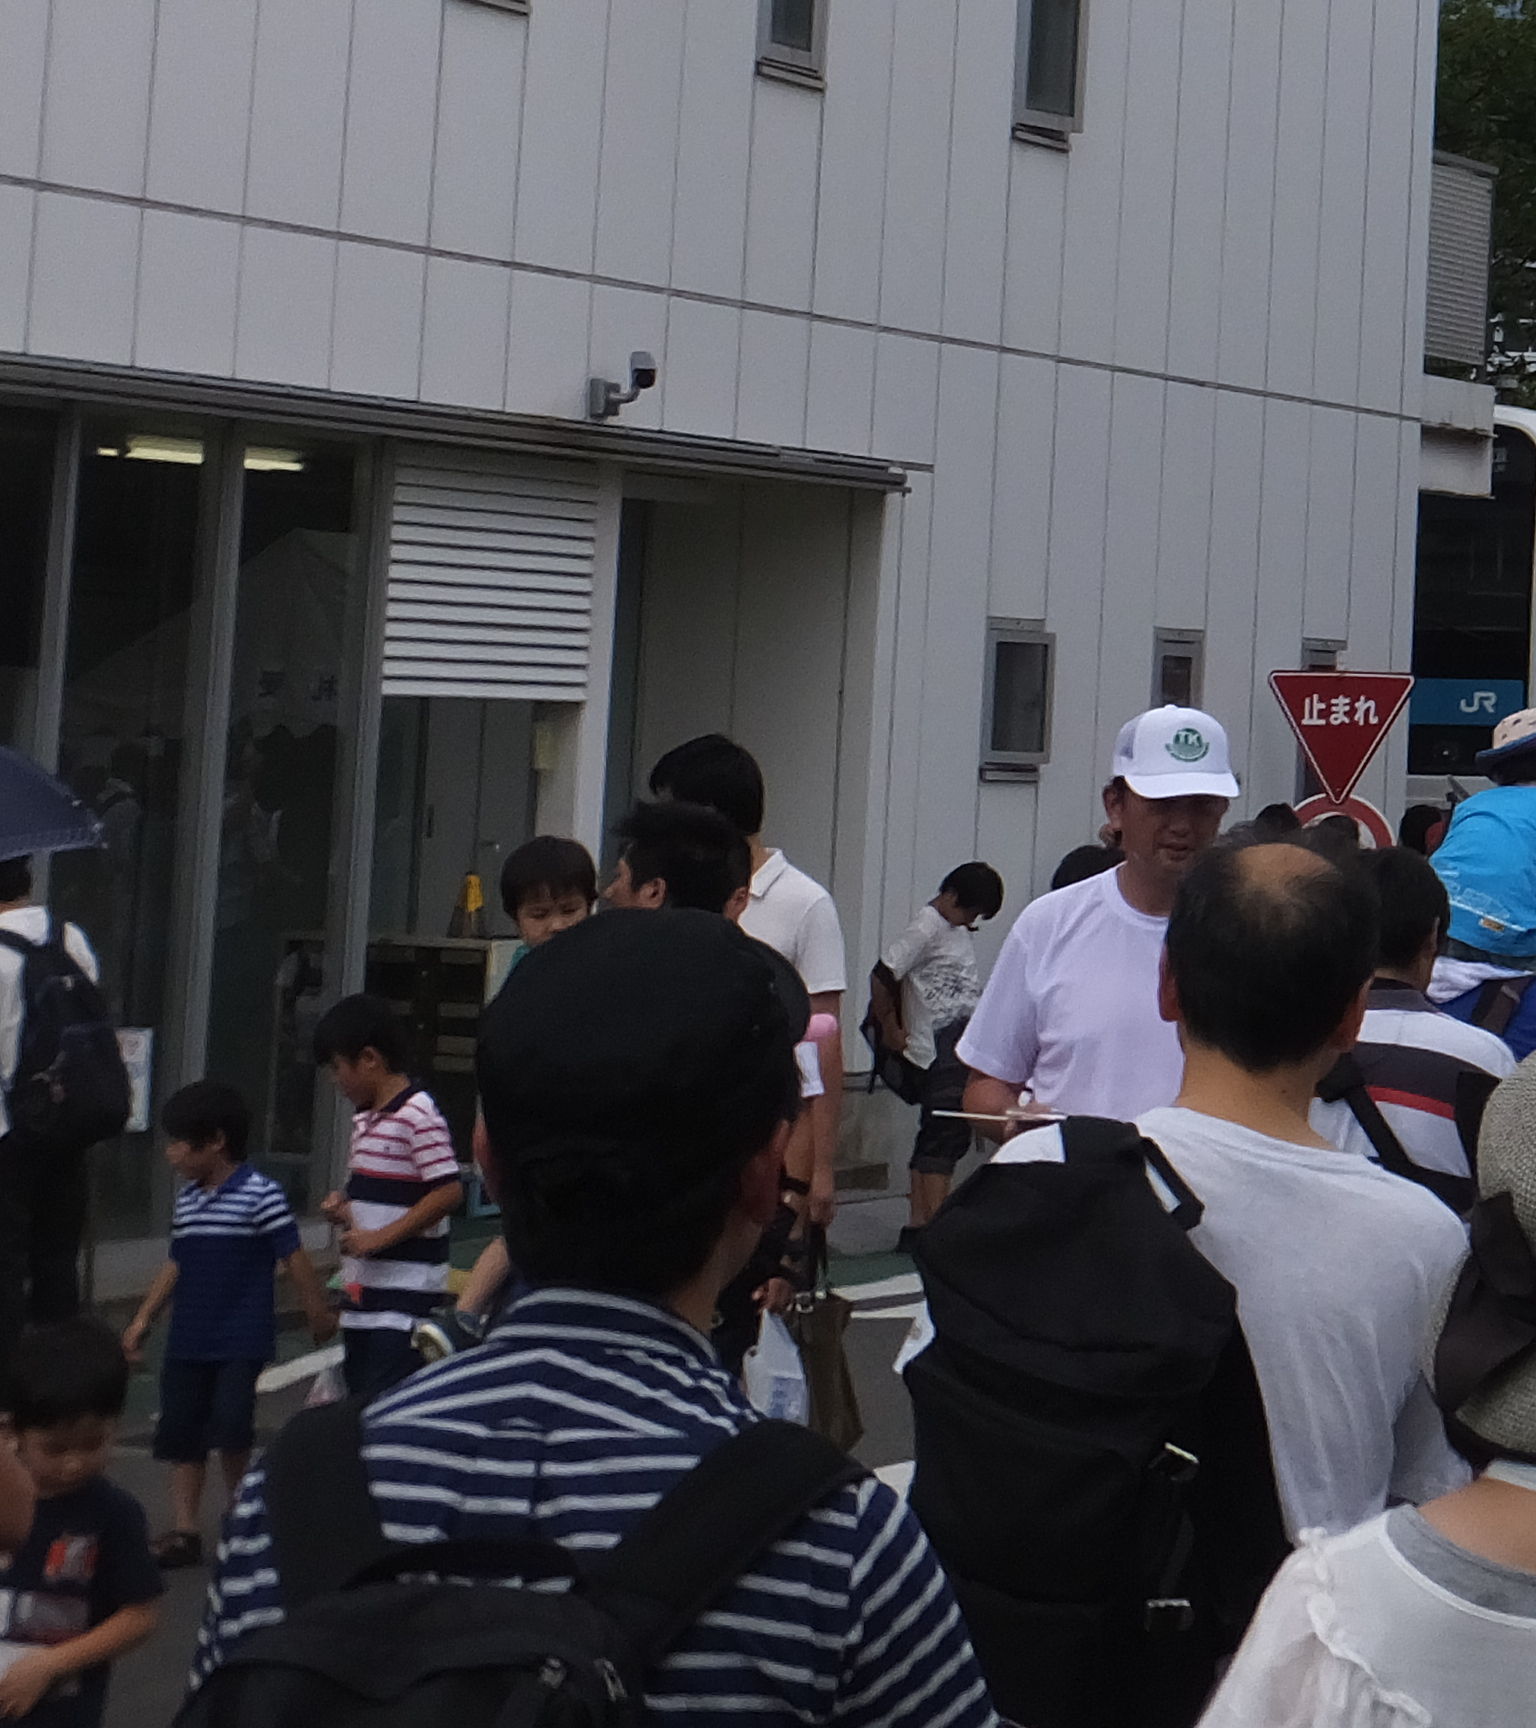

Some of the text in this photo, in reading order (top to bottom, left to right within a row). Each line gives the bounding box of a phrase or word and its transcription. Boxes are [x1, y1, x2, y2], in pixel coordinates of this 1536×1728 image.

[1301, 693, 1379, 726] 止まれ
[1460, 691, 1497, 714] JR
